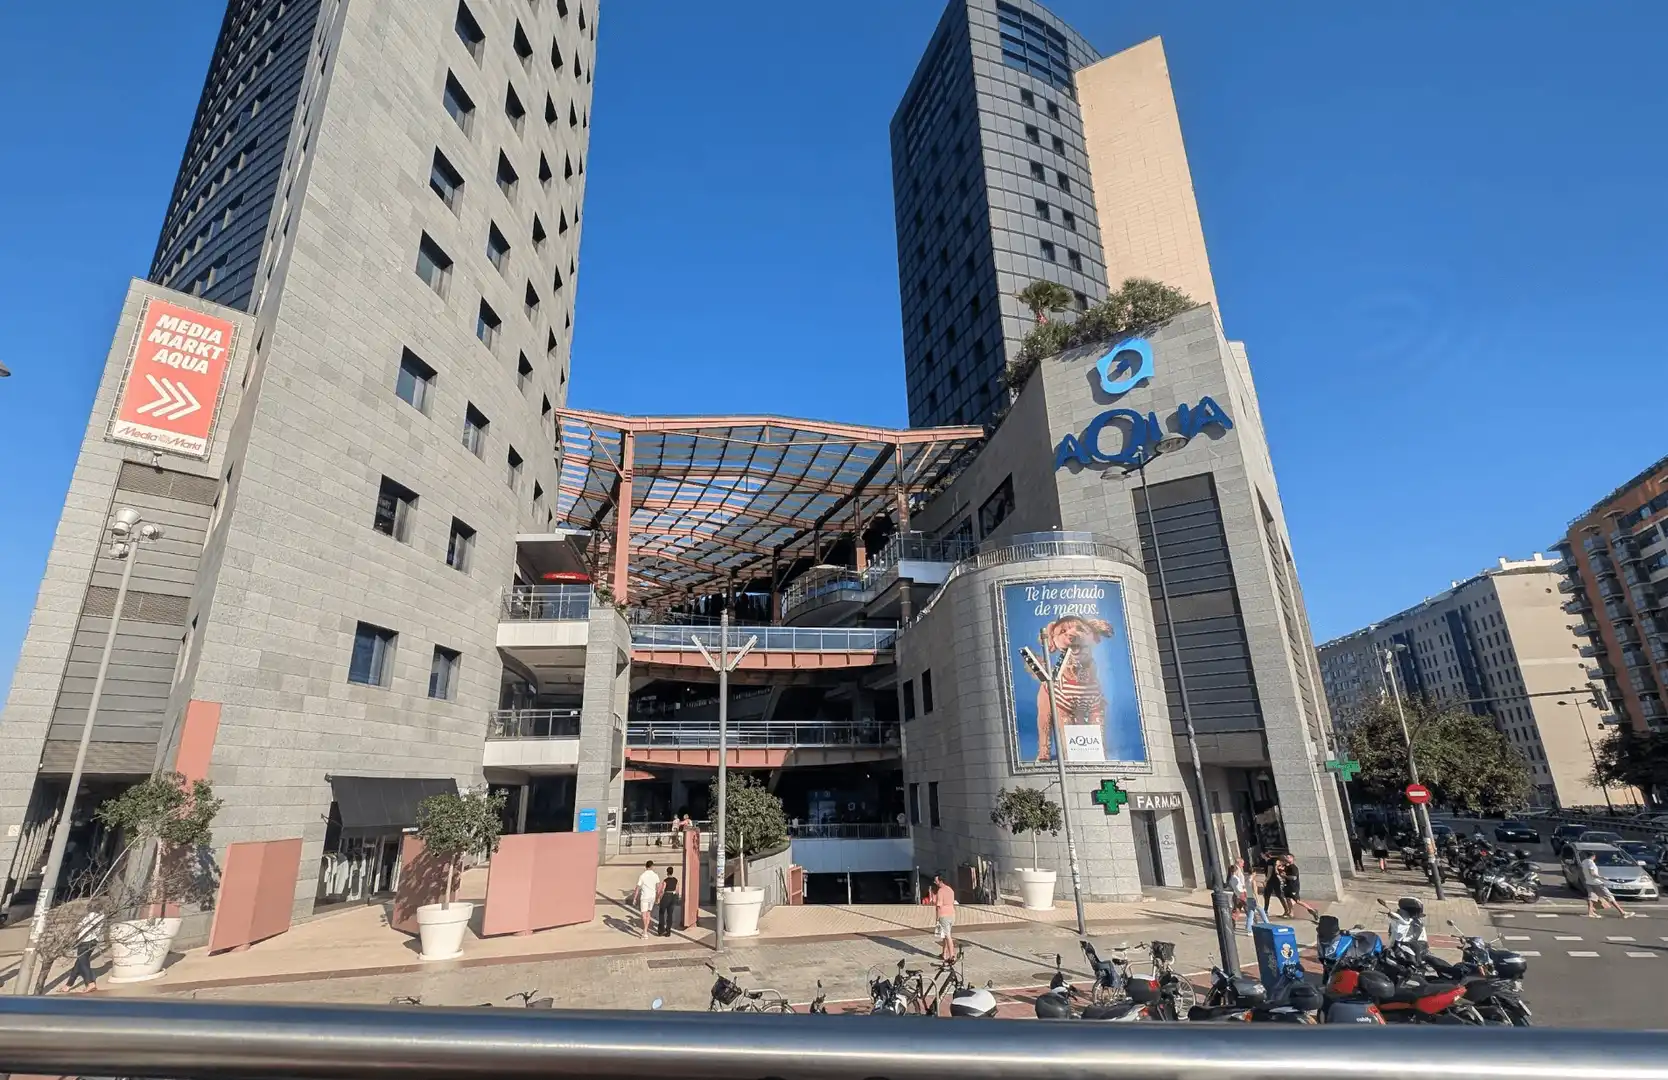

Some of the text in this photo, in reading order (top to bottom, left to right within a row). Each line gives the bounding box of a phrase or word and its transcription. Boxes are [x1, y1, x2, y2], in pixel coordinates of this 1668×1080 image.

[156, 314, 222, 344] MEDIA
[148, 329, 224, 360] MARKT
[152, 349, 208, 374] AQUA
[118, 426, 201, 450] Media Markt
[1054, 396, 1233, 473] AQUA
[1025, 584, 1104, 601] Te he echado
[1034, 601, 1051, 615] de
[1069, 735, 1100, 747] AQUA
